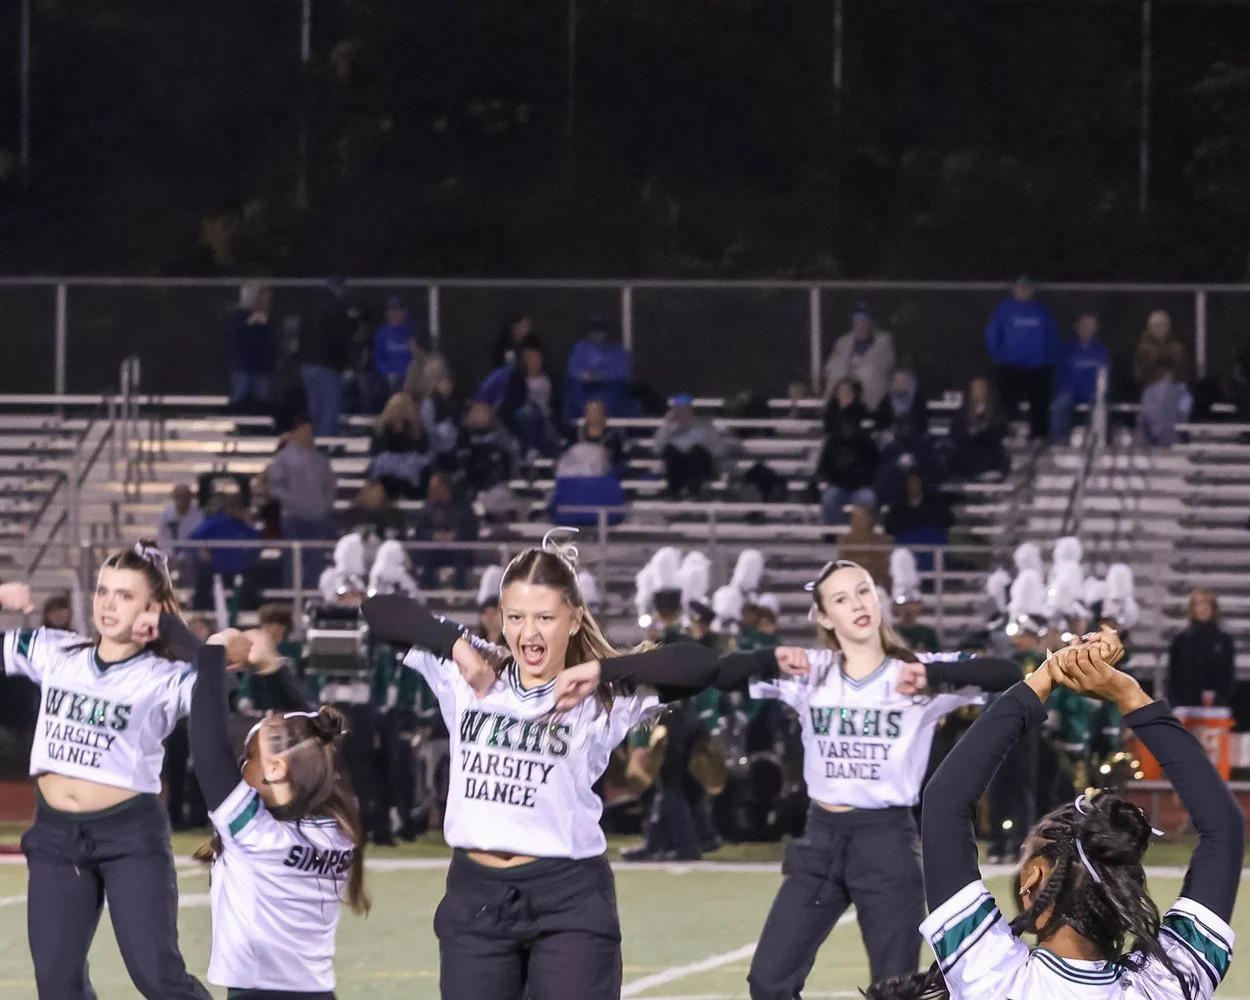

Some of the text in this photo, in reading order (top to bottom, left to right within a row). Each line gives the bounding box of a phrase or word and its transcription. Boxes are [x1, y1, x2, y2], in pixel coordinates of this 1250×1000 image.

[45, 687, 132, 732] WKHS
[810, 707, 903, 738] WKHS
[45, 720, 116, 751] VARSITY
[460, 709, 571, 758] WKHS
[48, 742, 102, 768] DANCE
[818, 740, 892, 760] VARSITY
[461, 749, 554, 784] VARSITY
[825, 761, 881, 781] DANCE
[464, 777, 537, 807] DANCE
